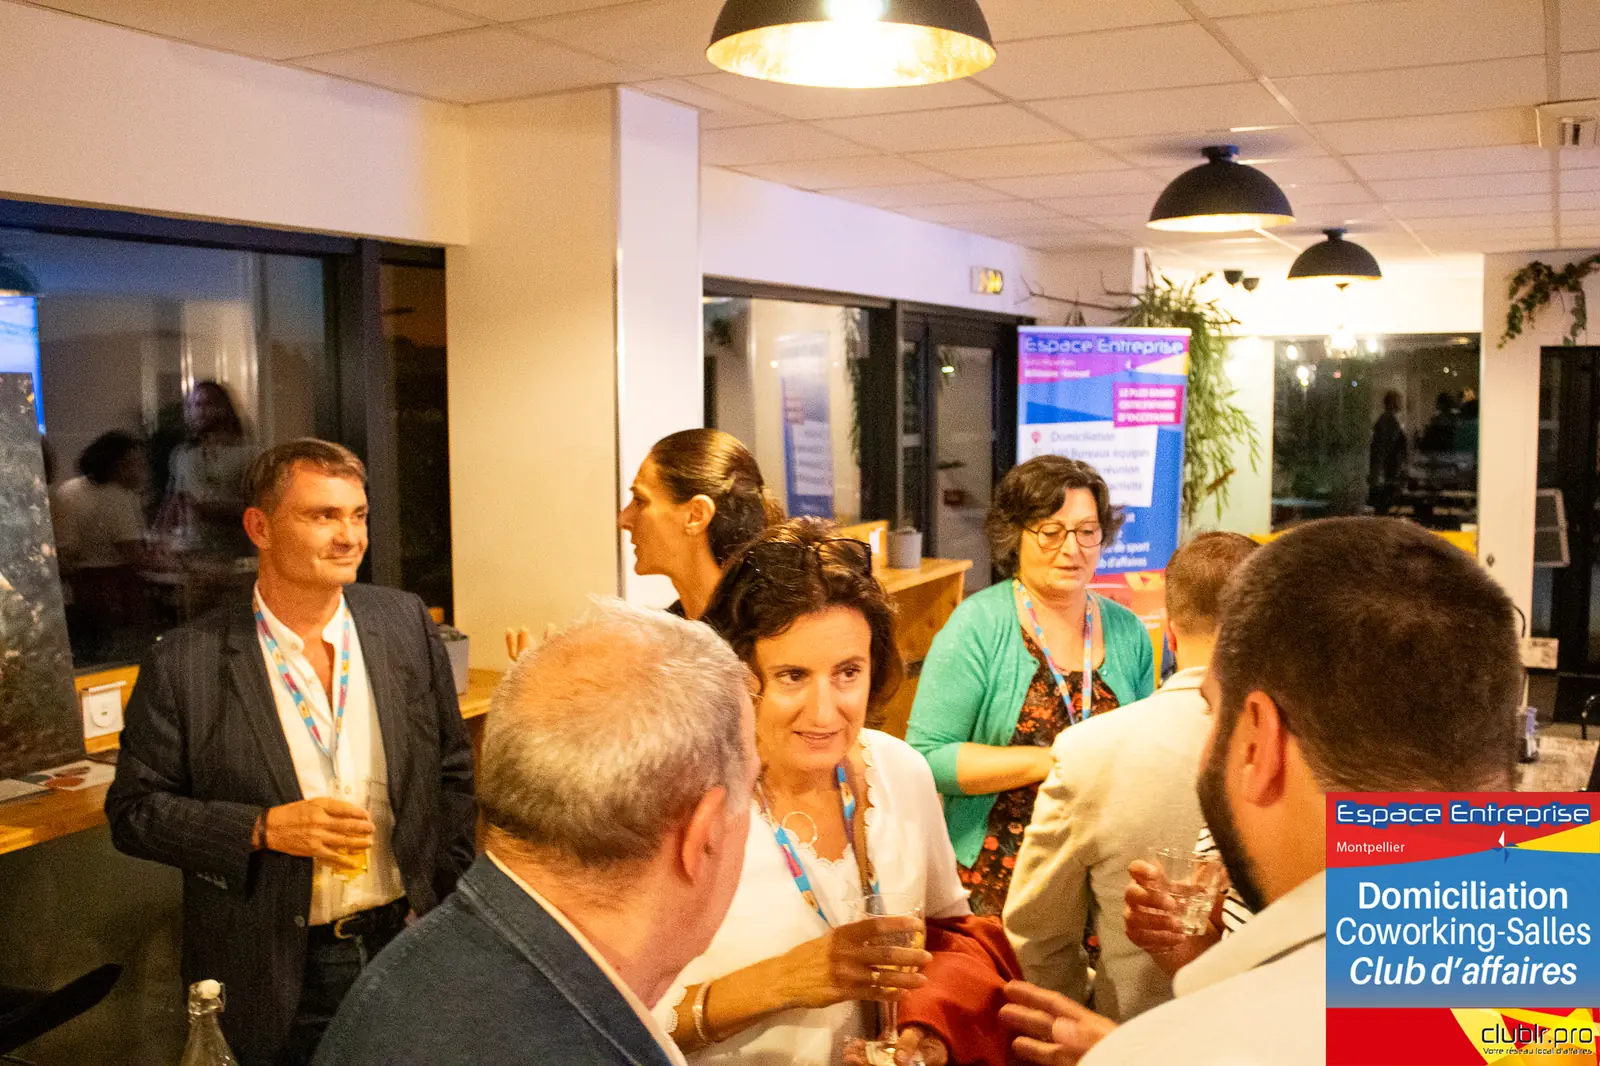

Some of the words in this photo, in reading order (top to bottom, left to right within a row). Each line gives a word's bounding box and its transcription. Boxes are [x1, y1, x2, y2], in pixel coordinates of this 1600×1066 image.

[1024, 337, 1093, 353] Espace
[1097, 338, 1183, 355] Entreprise
[1051, 431, 1116, 443] Domiciliation
